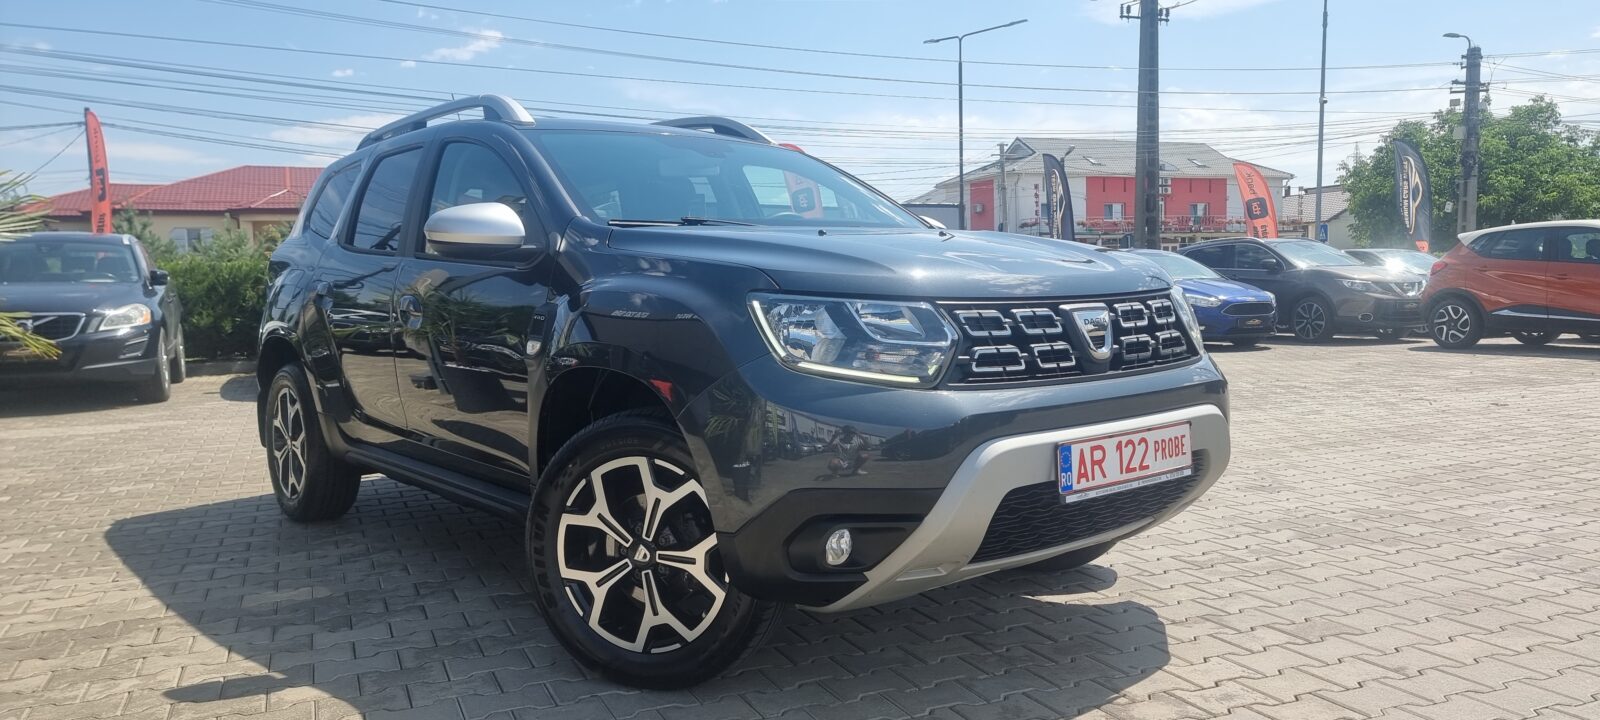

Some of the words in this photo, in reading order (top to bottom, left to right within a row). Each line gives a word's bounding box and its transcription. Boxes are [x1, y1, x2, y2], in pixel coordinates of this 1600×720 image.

[1084, 317, 1107, 326] DACIA
[1076, 444, 1107, 485] AR
[1115, 436, 1150, 475] 122
[1153, 434, 1187, 462] PROBE
[1061, 471, 1072, 487] RO
